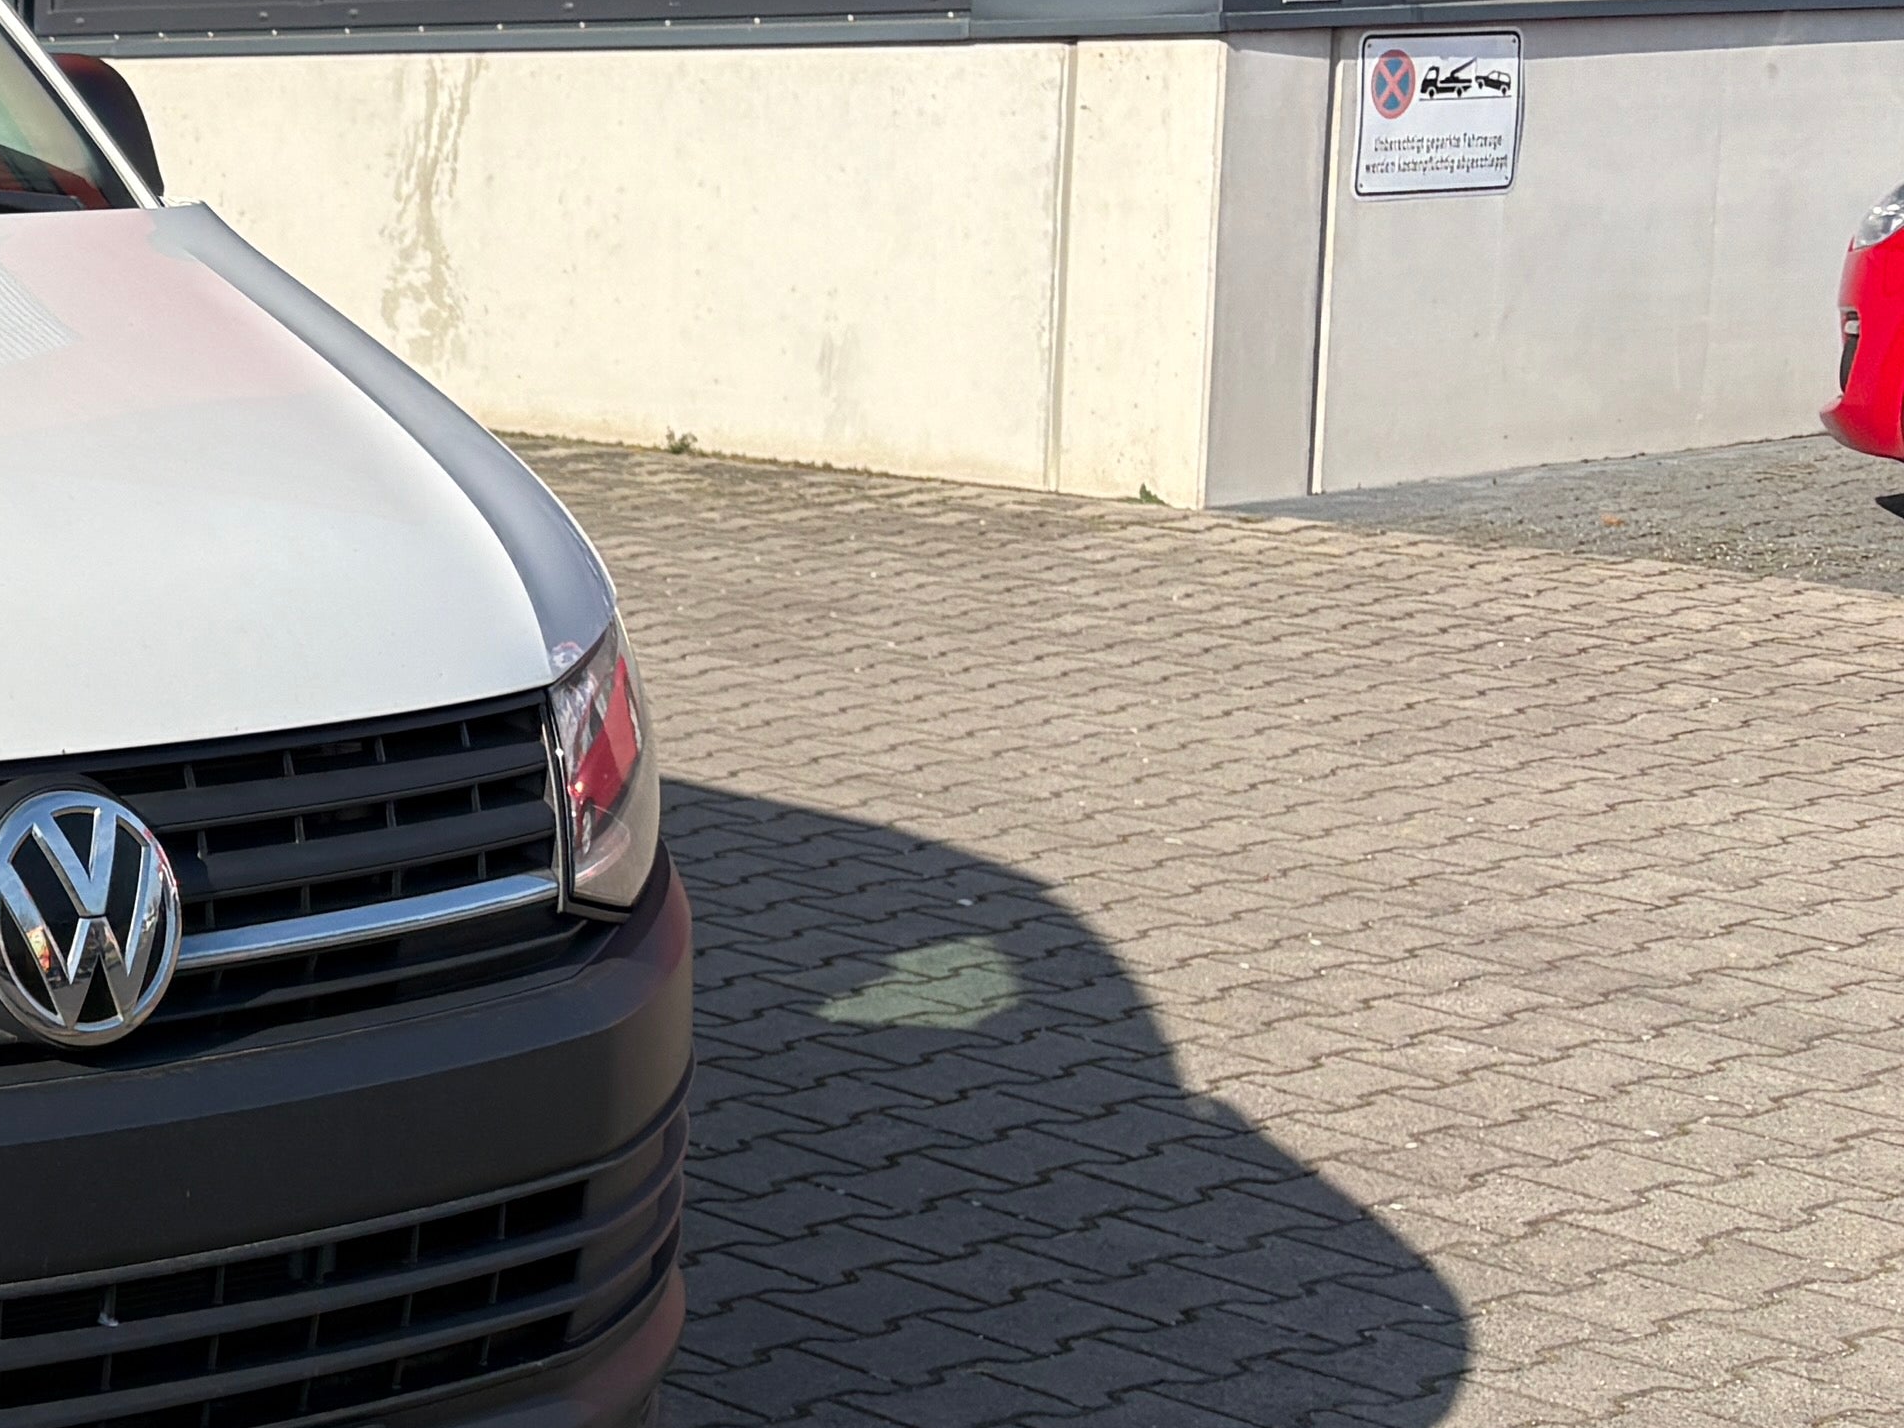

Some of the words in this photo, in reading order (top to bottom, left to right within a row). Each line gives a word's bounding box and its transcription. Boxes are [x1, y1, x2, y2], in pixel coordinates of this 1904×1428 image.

[1374, 136, 1424, 154] Unberechtigt
[1426, 135, 1461, 154] geparkte
[1463, 132, 1502, 151] Fahrzeuge
[1365, 159, 1396, 174] werden
[1397, 155, 1455, 175] kostenpflichtig
[1456, 153, 1508, 172] abgeschleppt
